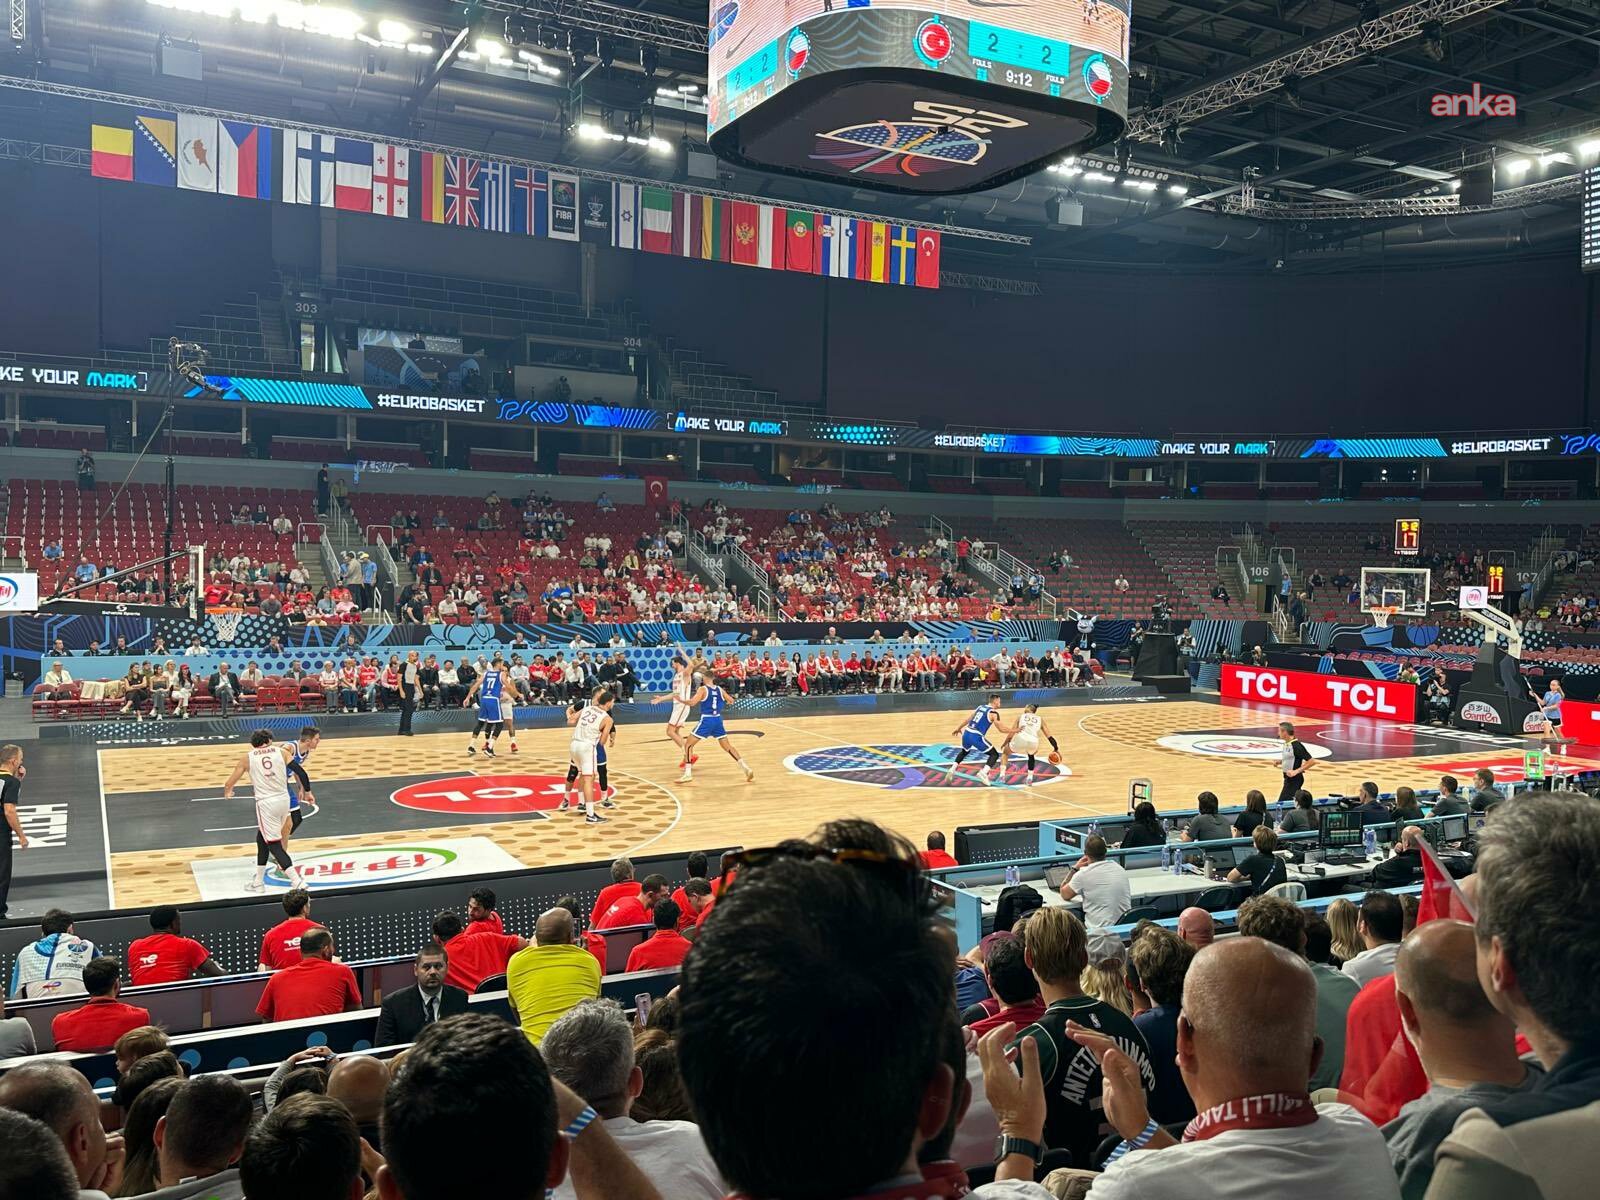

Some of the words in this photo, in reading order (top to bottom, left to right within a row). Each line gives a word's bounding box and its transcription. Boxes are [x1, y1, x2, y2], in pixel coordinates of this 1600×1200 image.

[1005, 69, 1033, 87] 9:12
[555, 209, 572, 220] FIBA
[295, 302, 318, 314] 303
[623, 337, 642, 348] 304
[32, 368, 79, 386] YOUR
[86, 371, 138, 390] MARK
[377, 394, 486, 413] #EUROBASKET
[675, 416, 710, 431] MAKE
[714, 419, 745, 433] YOUR
[749, 421, 782, 435] MARK
[934, 434, 1006, 448] #EUROBASKET
[1161, 442, 1196, 454] MAKE
[1199, 442, 1230, 454] YOUR
[1234, 442, 1268, 454] MARK
[1451, 438, 1550, 454] #EUROBASKET
[1250, 566, 1269, 577] 106
[486, 677, 497, 689] 77
[1236, 670, 1297, 701] TCL
[1326, 680, 1397, 715] TCL
[581, 710, 598, 724] 23
[261, 756, 273, 769] 6
